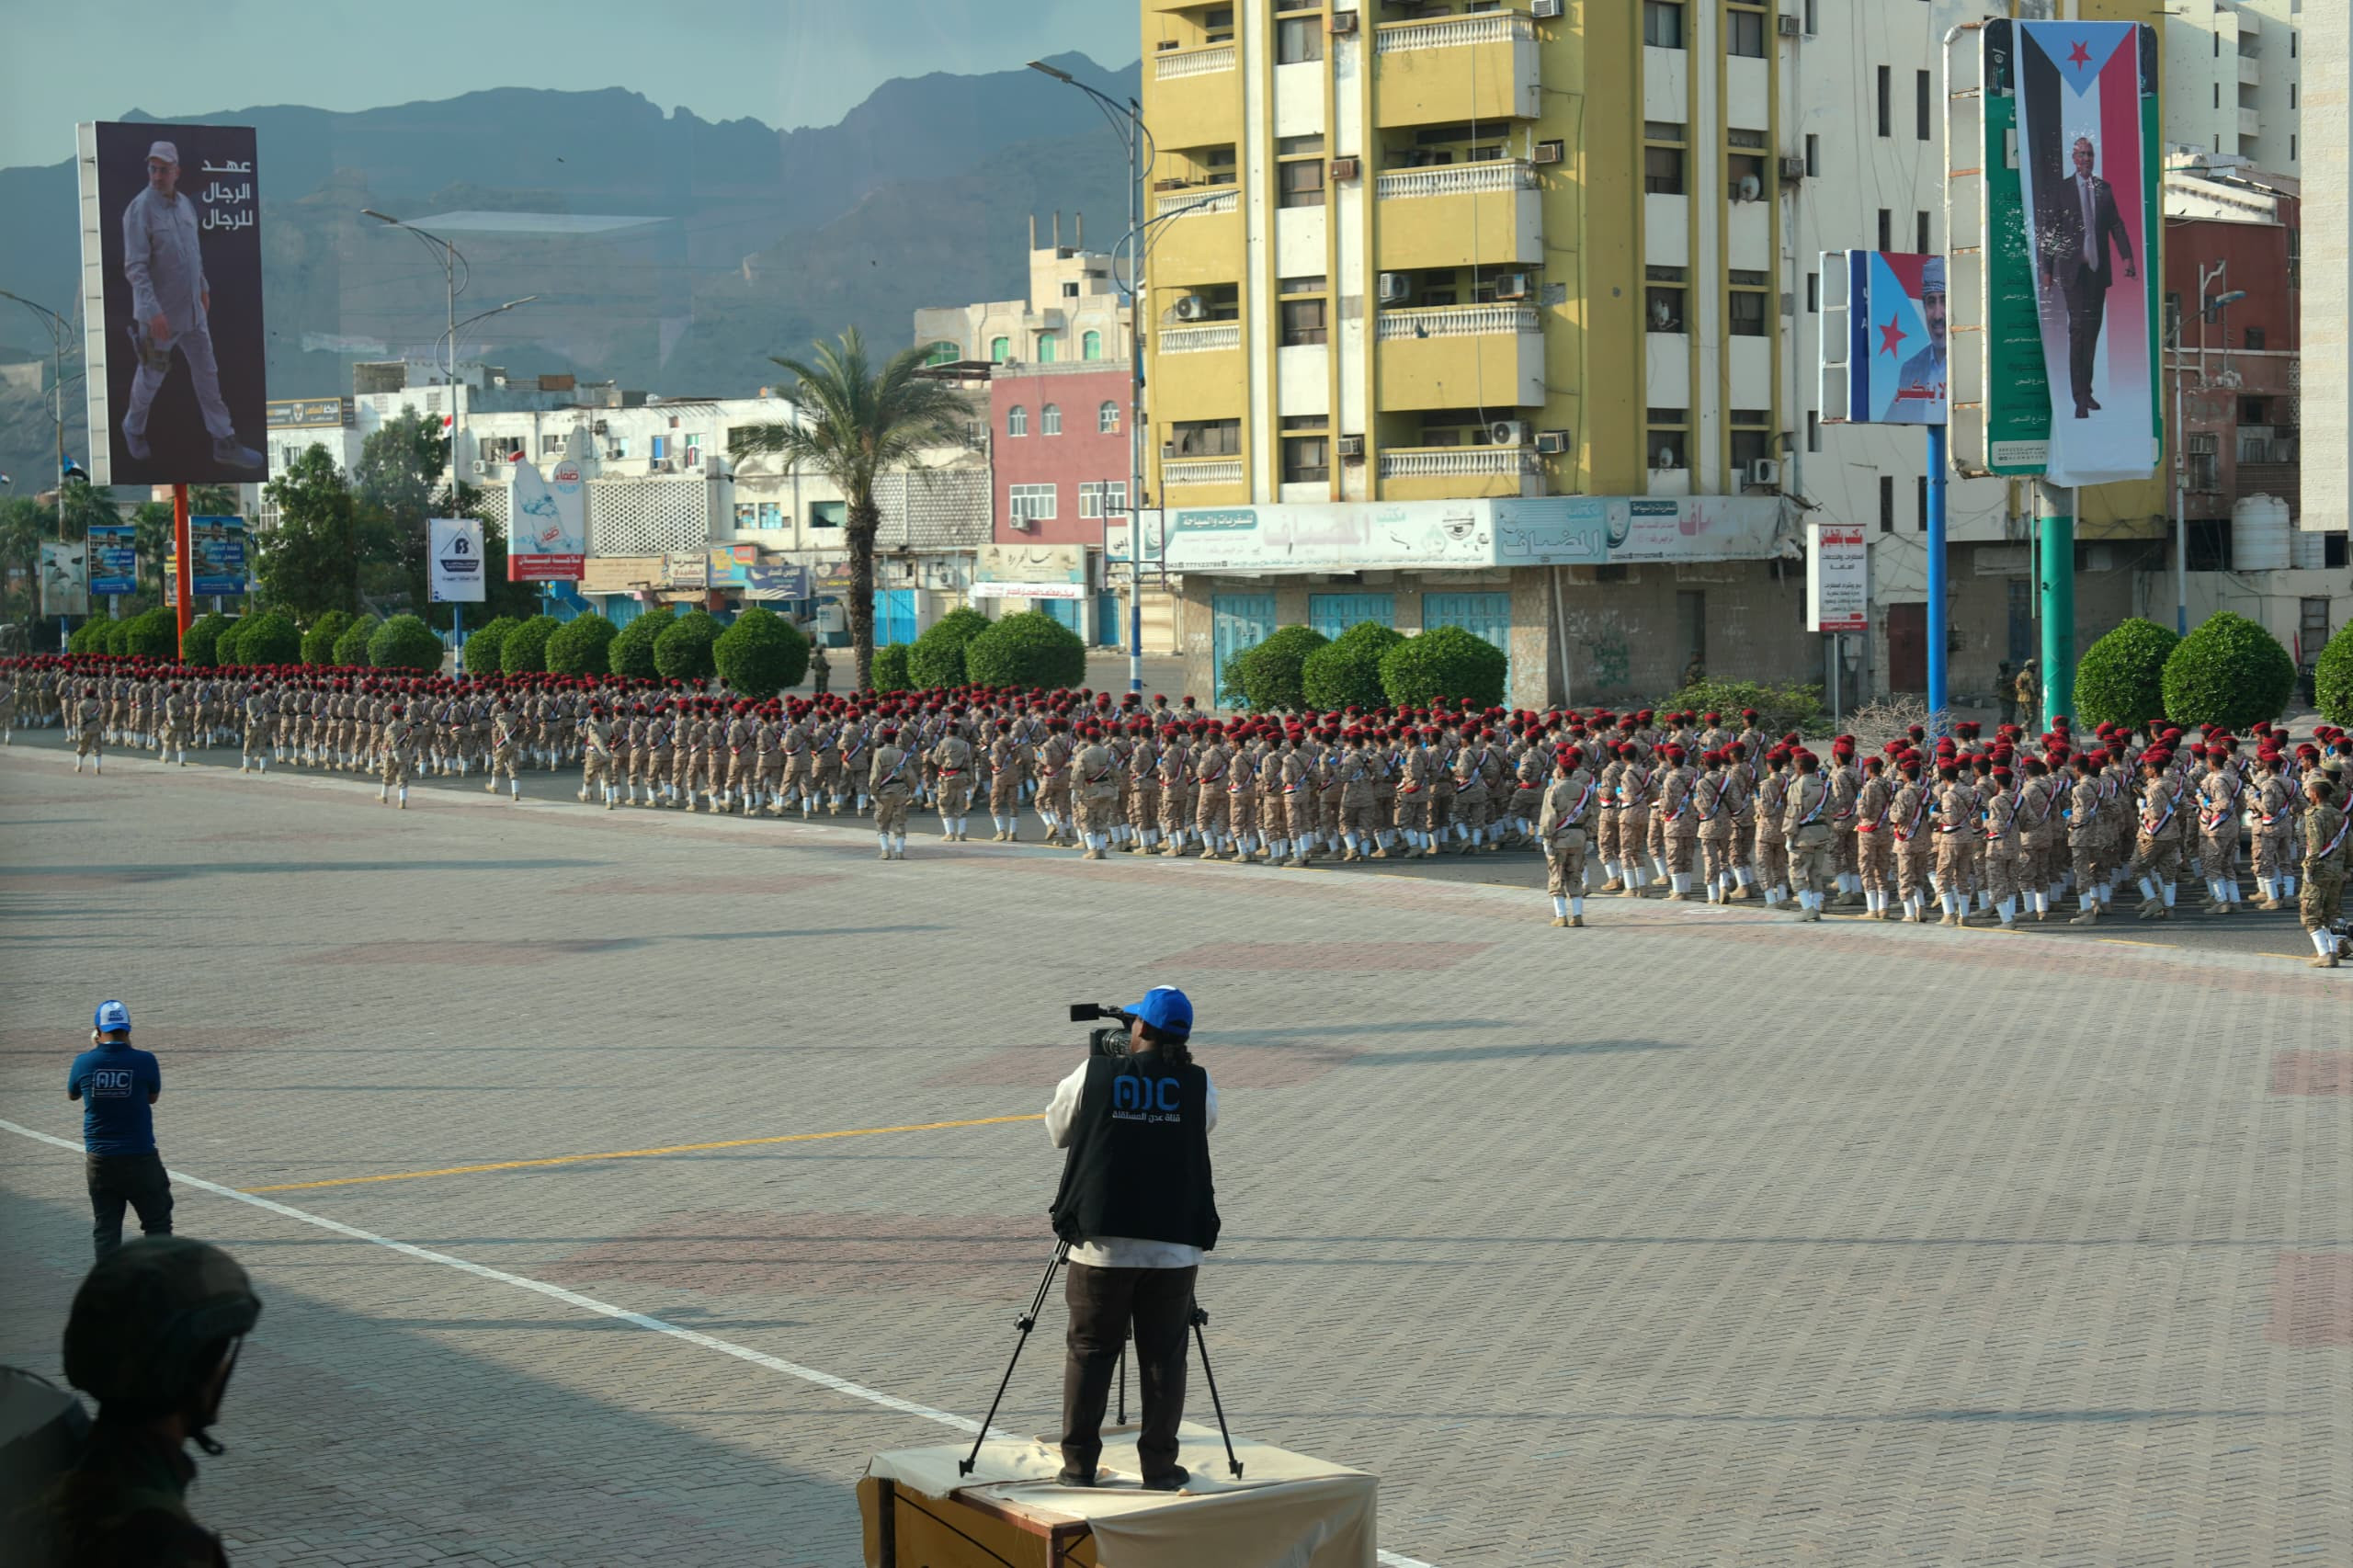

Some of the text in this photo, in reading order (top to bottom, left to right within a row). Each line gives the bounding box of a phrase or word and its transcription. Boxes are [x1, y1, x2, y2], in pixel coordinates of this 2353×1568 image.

[201, 159, 251, 173] عهد
[202, 182, 250, 204] الرجال
[202, 209, 253, 231] للرجال
[1502, 529, 1600, 562] المضياف
[1112, 1110, 1146, 1122] المستقلة
[1165, 1113, 1181, 1122] قناة
